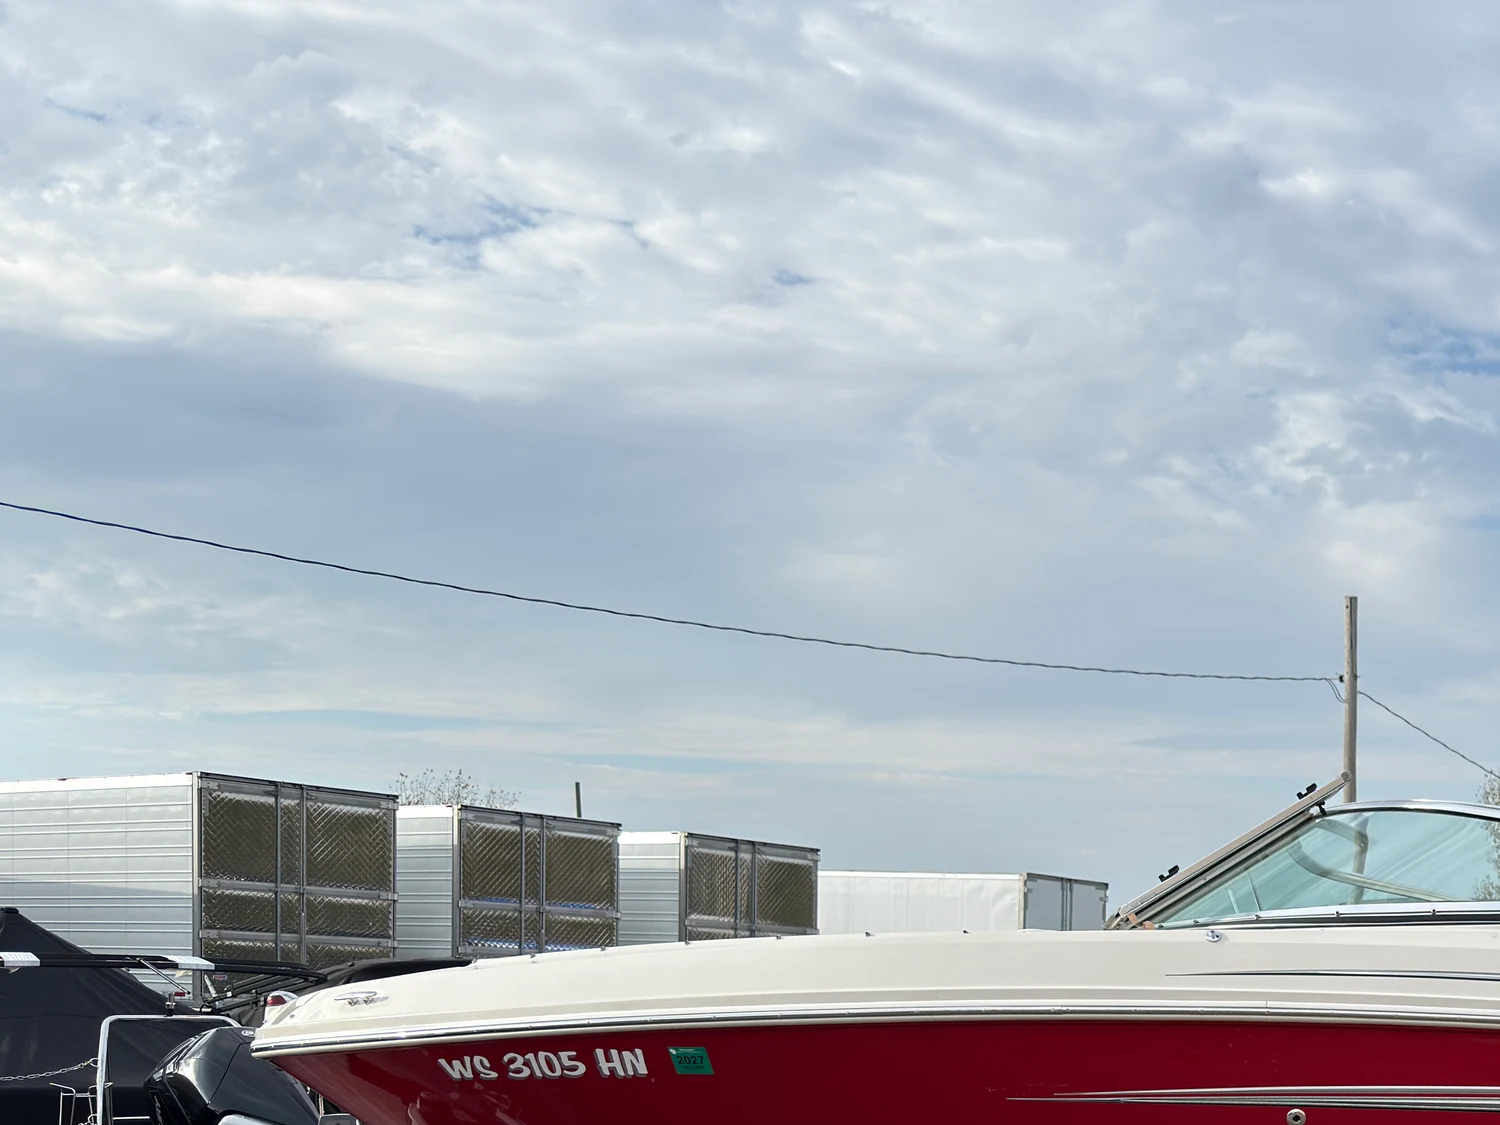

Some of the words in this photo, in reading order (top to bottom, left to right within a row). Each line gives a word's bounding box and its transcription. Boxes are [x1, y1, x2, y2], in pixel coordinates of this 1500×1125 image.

[438, 1055, 498, 1080] WS
[503, 1051, 586, 1079] 3105
[595, 1048, 648, 1078] HN
[676, 1055, 704, 1065] 2027
